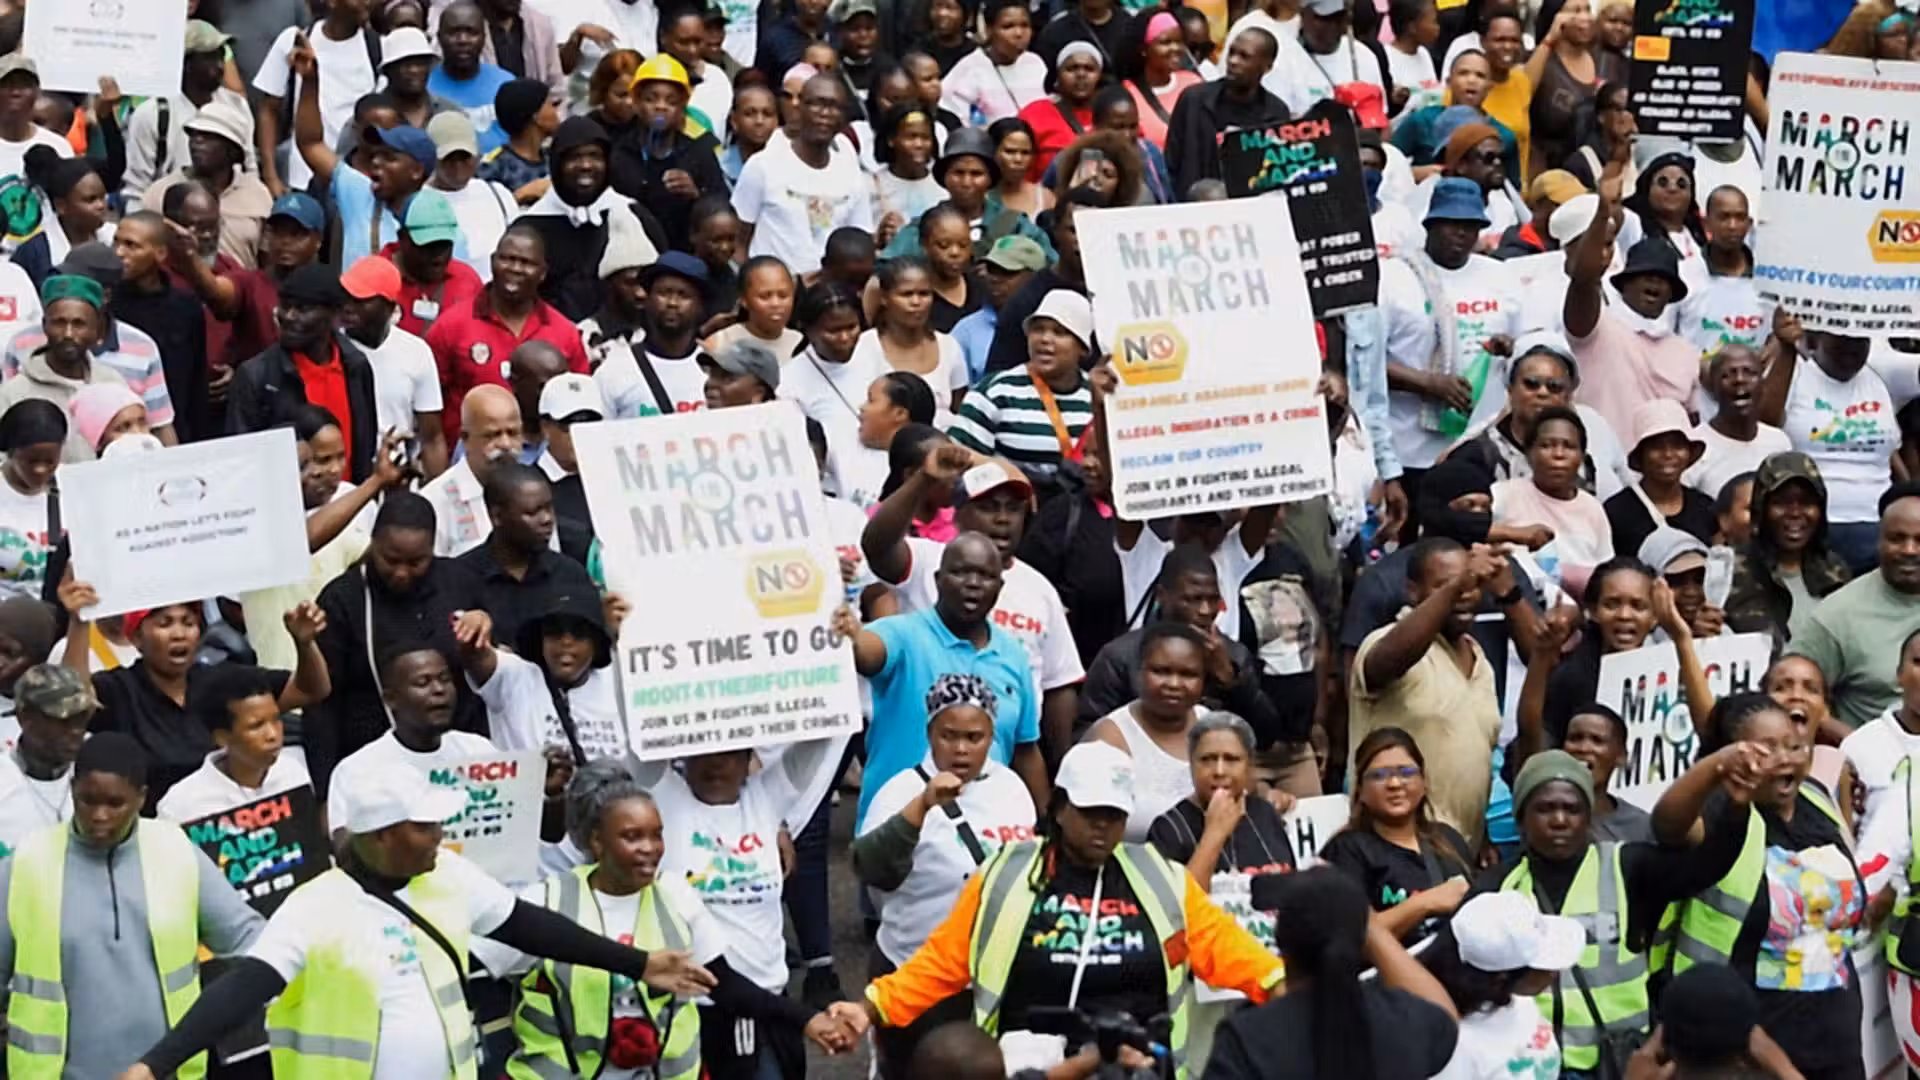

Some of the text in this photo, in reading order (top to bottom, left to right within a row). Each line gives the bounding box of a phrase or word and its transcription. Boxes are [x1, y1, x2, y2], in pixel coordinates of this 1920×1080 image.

[1240, 117, 1332, 151] MARCH
[1781, 110, 1909, 156] MARCH
[1264, 142, 1316, 165] AND
[1776, 155, 1905, 202] MARCH
[1117, 224, 1259, 270] MARCH
[1128, 269, 1270, 319] MARCH
[1827, 318, 1850, 329] AND
[1254, 412, 1265, 424] IS
[1270, 411, 1278, 422] A
[614, 430, 794, 491] MARCH
[1125, 464, 1304, 495] JOIN US IN FIGHTING ILLEGAL
[1208, 490, 1233, 503] AND
[1238, 485, 1275, 499] THEIR
[630, 489, 810, 556] MARCH
[993, 609, 1042, 635] RCH
[629, 644, 677, 673] IT'S
[688, 634, 752, 666] TIME
[763, 629, 798, 656] TO
[1622, 661, 1752, 724] MACH
[641, 697, 827, 730] JOIN US IN FIGHTING ILLEGAL
[642, 713, 850, 750] IMMIGRANTS AND THEIR CRIMES
[429, 760, 518, 786] MARCH
[1616, 735, 1693, 790] MAR
[189, 795, 293, 844] MARCH
[219, 826, 278, 860] AND
[228, 842, 305, 885] ARCH
[1033, 893, 1139, 916] MARCH
